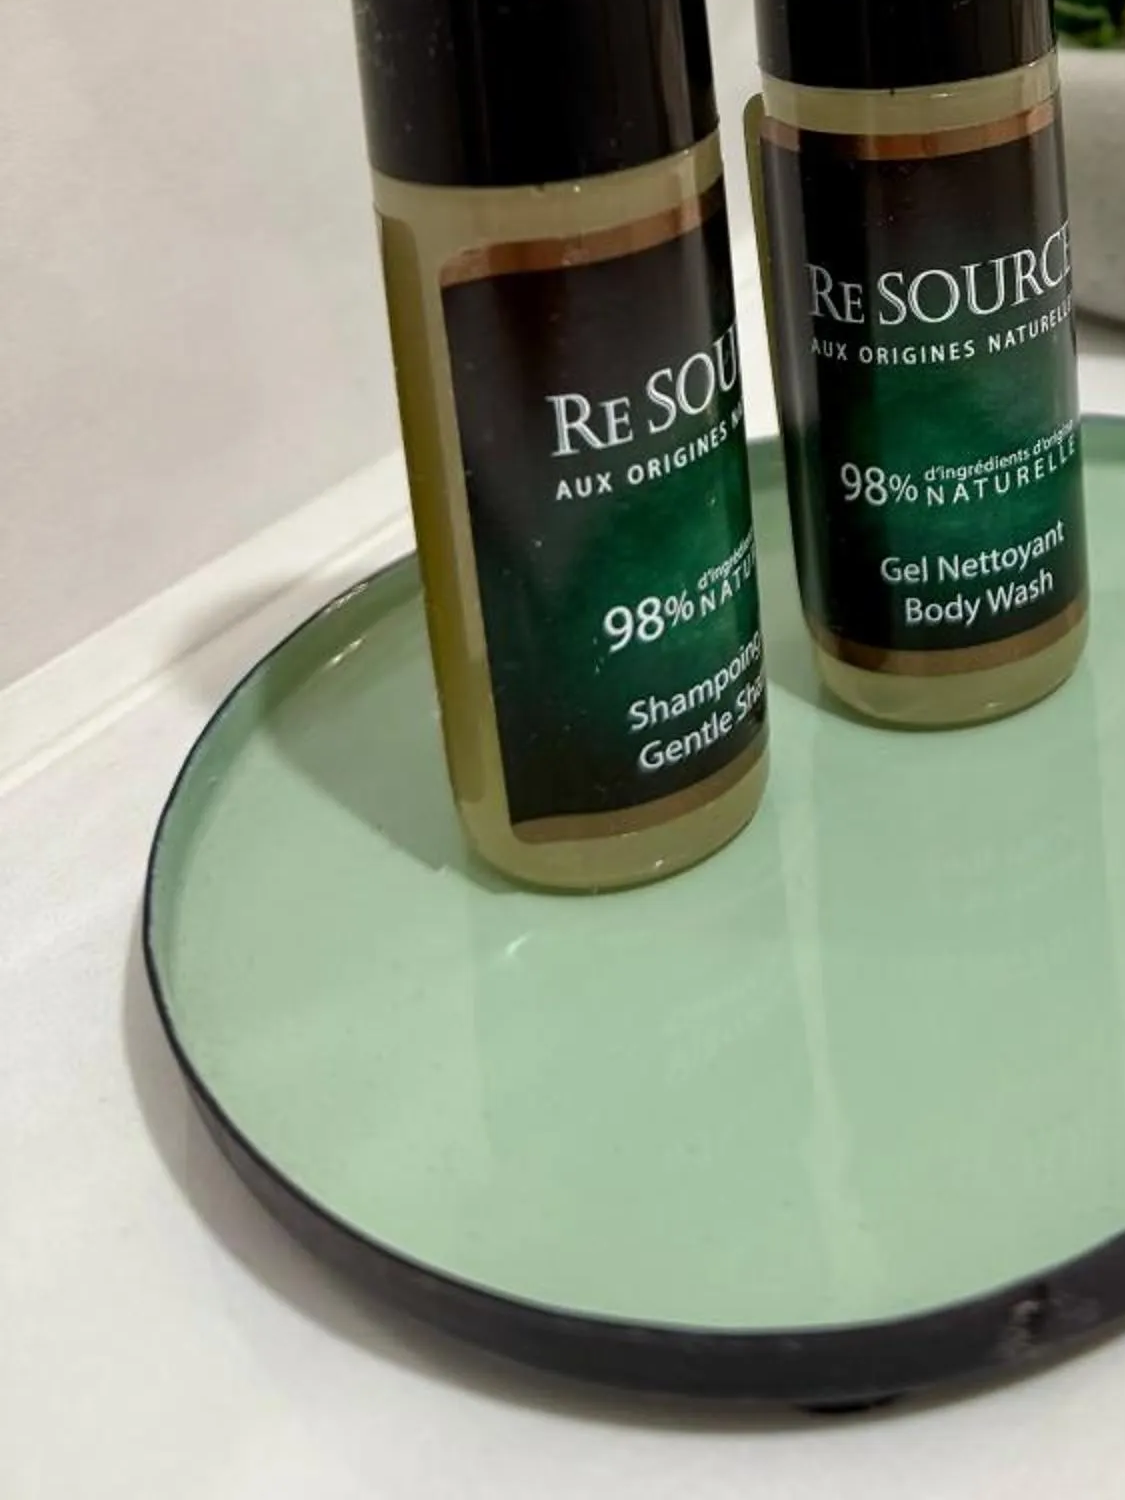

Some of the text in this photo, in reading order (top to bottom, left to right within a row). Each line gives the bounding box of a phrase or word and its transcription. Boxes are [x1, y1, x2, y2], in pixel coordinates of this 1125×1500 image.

[811, 338, 848, 361] AUX
[859, 339, 975, 365] ORIGINES
[555, 420, 727, 500] AUX ORIGINES
[840, 461, 918, 506] 98%
[924, 448, 1030, 484] d'ingrédients
[880, 520, 1065, 583] Gel Nettoyant
[603, 589, 694, 653] 98%
[905, 568, 1054, 626] Body Wash
[628, 630, 760, 732] Shampoing
[638, 709, 734, 772] Gentle
